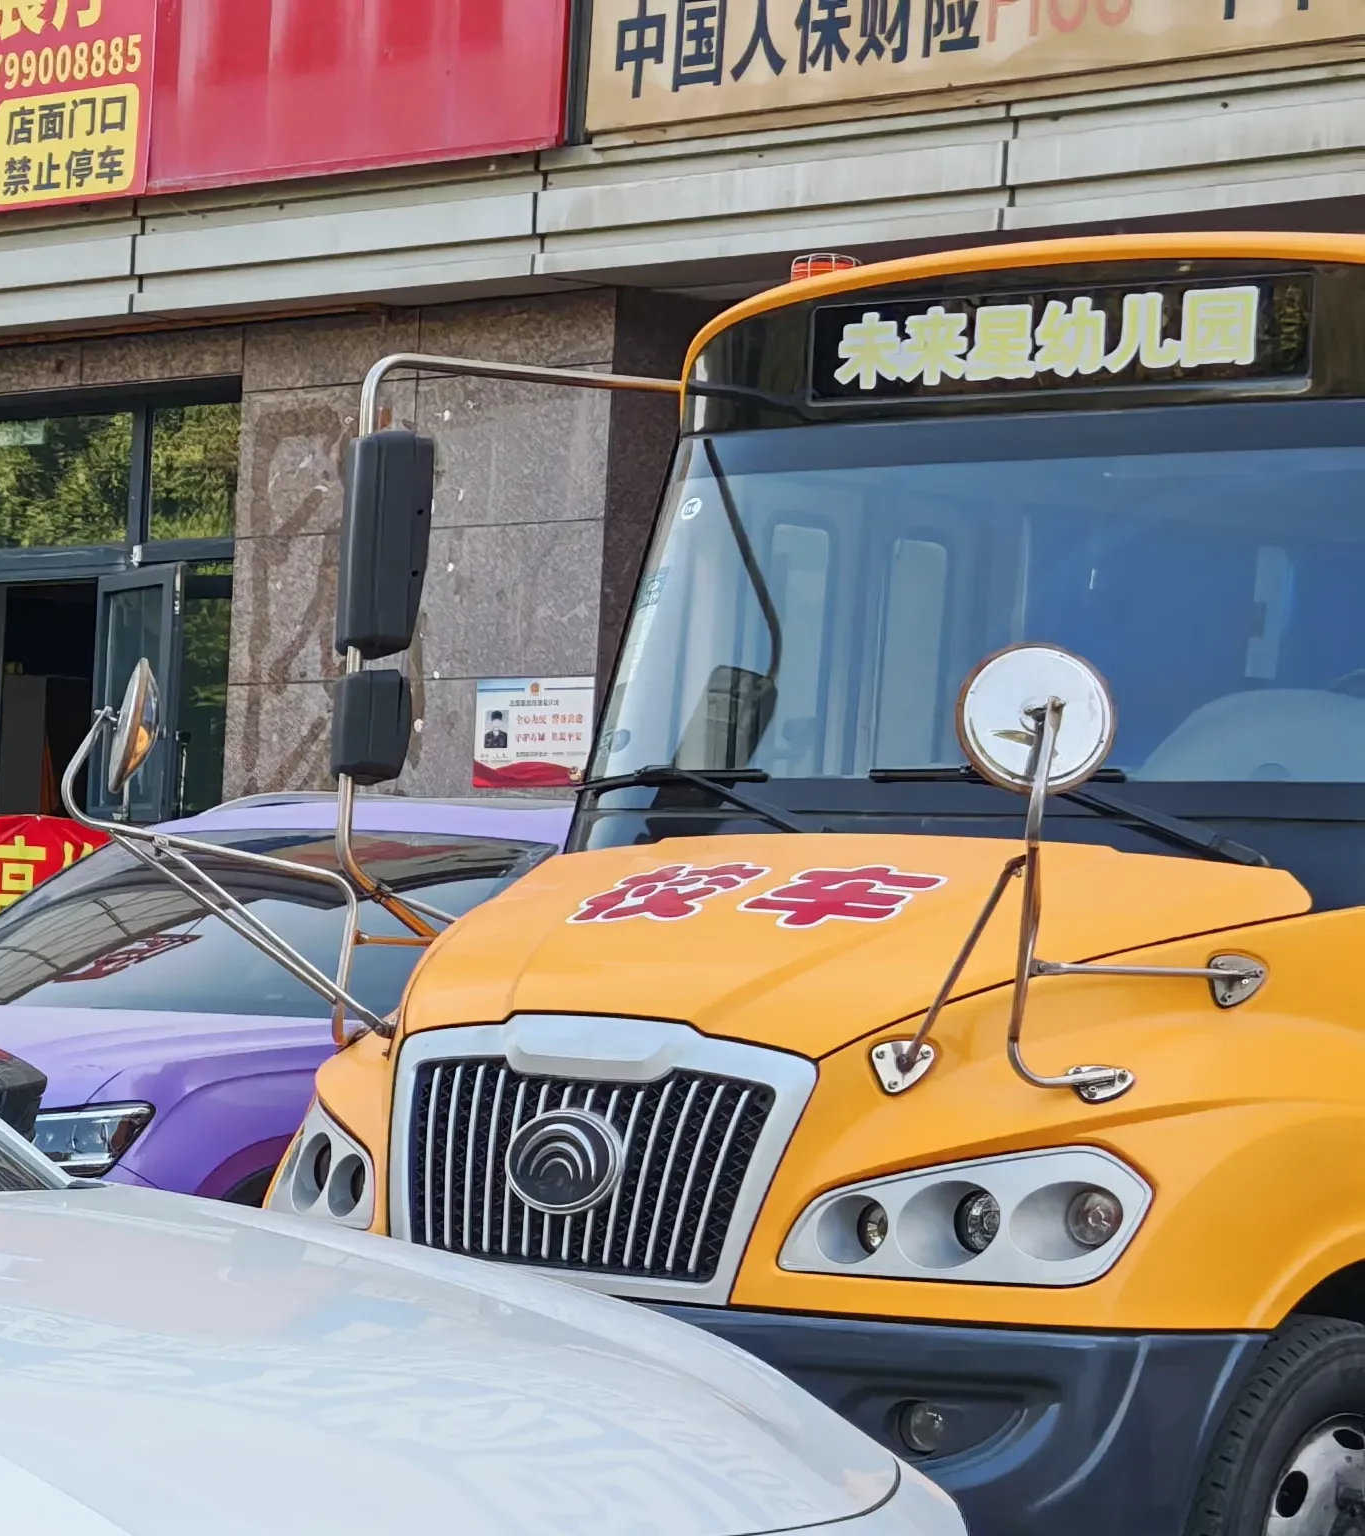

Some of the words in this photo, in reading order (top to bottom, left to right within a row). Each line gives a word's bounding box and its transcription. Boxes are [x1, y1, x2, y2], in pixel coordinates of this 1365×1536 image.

[7, 95, 128, 146] 店面门口
[3, 145, 125, 197] 禁止停车
[834, 284, 1261, 390] 未来星幼儿园
[565, 862, 949, 929] 校车
